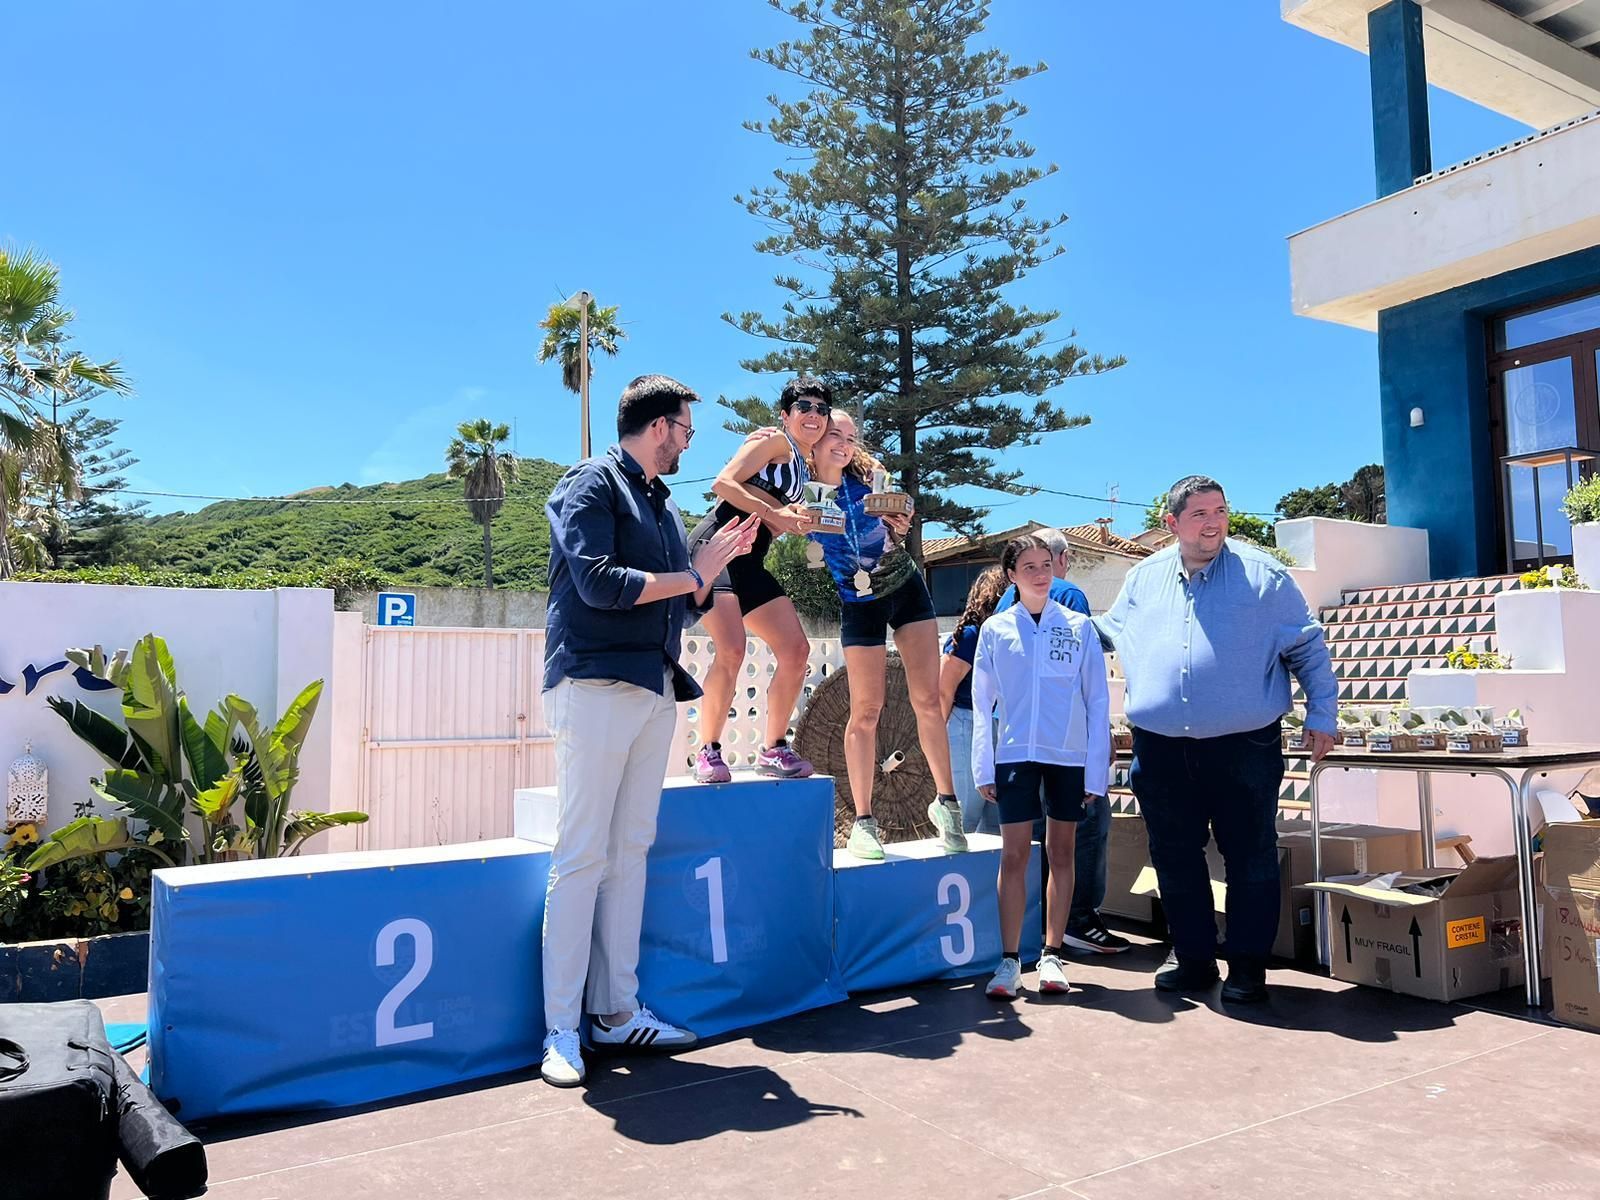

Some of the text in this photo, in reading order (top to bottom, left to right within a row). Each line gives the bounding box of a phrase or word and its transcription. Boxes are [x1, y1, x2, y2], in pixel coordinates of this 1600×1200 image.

[385, 597, 407, 624] P
[695, 857, 728, 963] 1
[938, 873, 975, 966] 3
[1451, 922, 1481, 934] CONTIENE
[1455, 931, 1480, 942] CRISTAL
[1354, 937, 1412, 956] MUY FRAGIL
[376, 918, 434, 1047] 2
